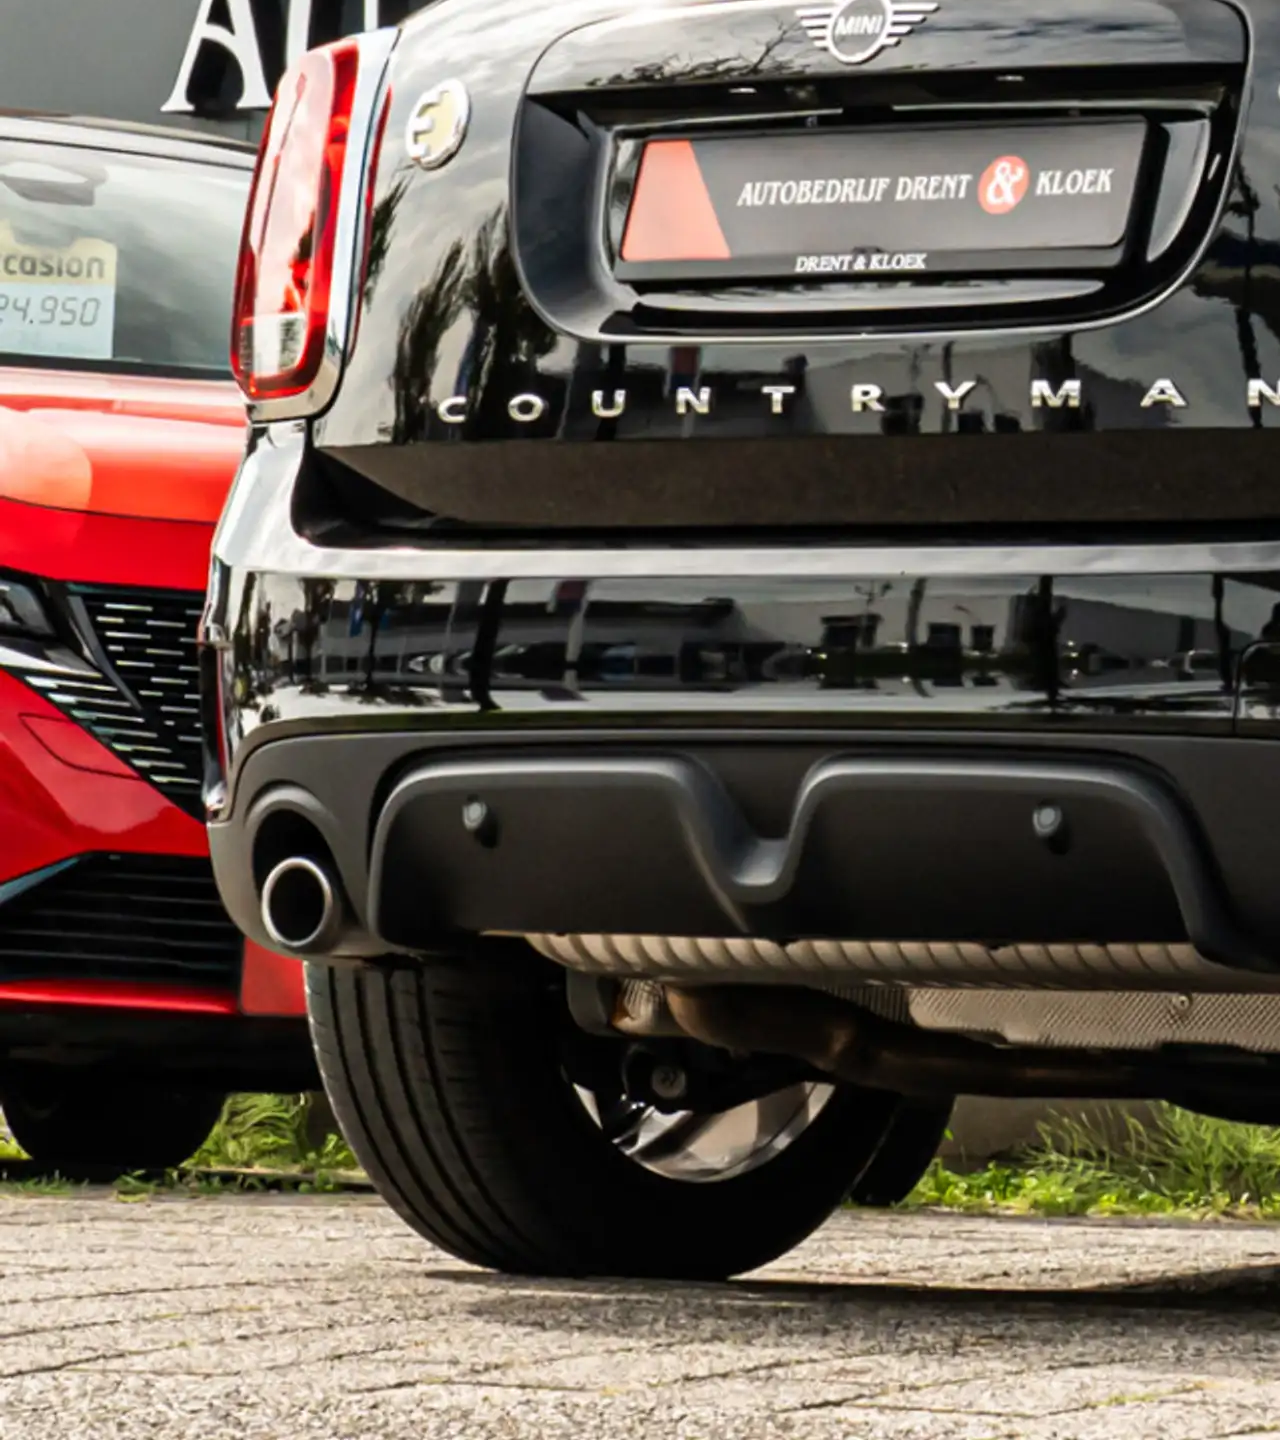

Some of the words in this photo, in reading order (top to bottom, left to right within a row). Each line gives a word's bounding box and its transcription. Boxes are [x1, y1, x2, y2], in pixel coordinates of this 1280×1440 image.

[835, 14, 883, 36] MINI
[736, 177, 891, 208] AUTOBEDRIJF
[895, 173, 973, 202] DRENT
[985, 161, 1023, 206] &
[1034, 168, 1115, 197] KLOEK
[0, 253, 106, 280] casion
[794, 255, 853, 273] DRENT
[868, 253, 928, 271] KLOEK
